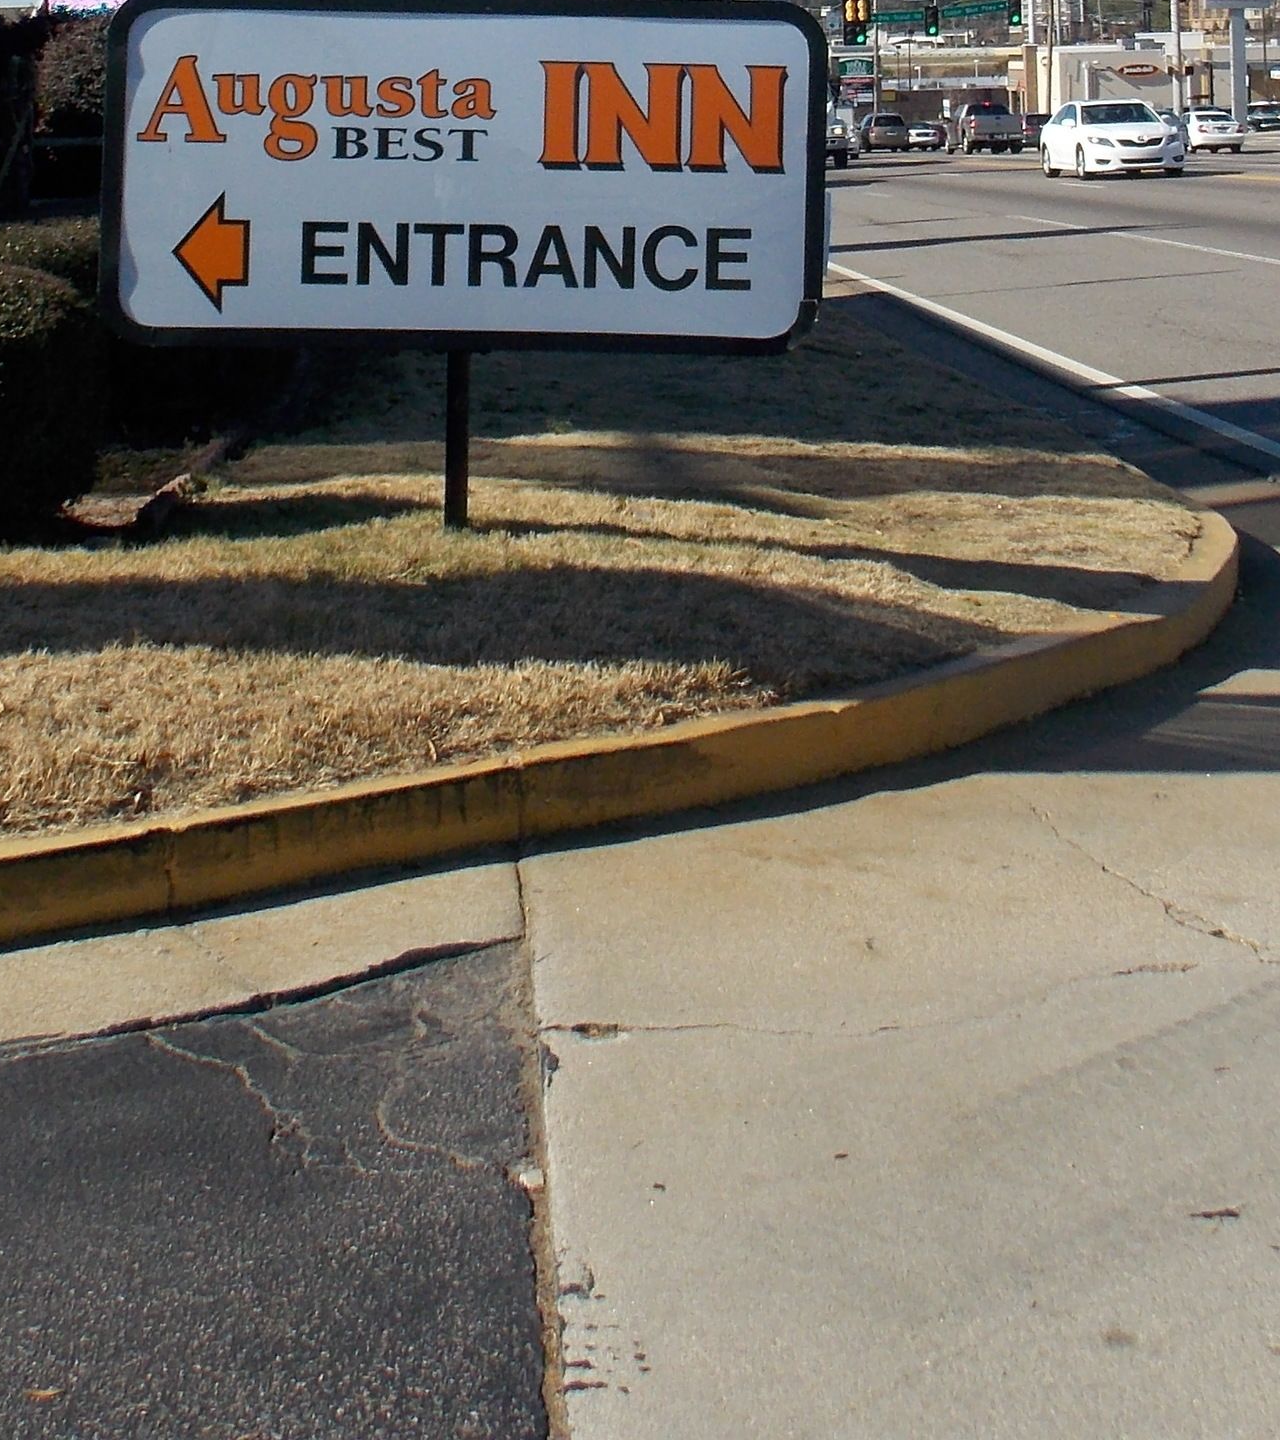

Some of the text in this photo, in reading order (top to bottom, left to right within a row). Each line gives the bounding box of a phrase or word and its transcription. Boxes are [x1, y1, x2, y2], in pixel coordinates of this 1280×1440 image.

[136, 53, 788, 173] Augusta INN
[331, 126, 489, 163] BEST
[300, 220, 753, 292] ENTRANCE
